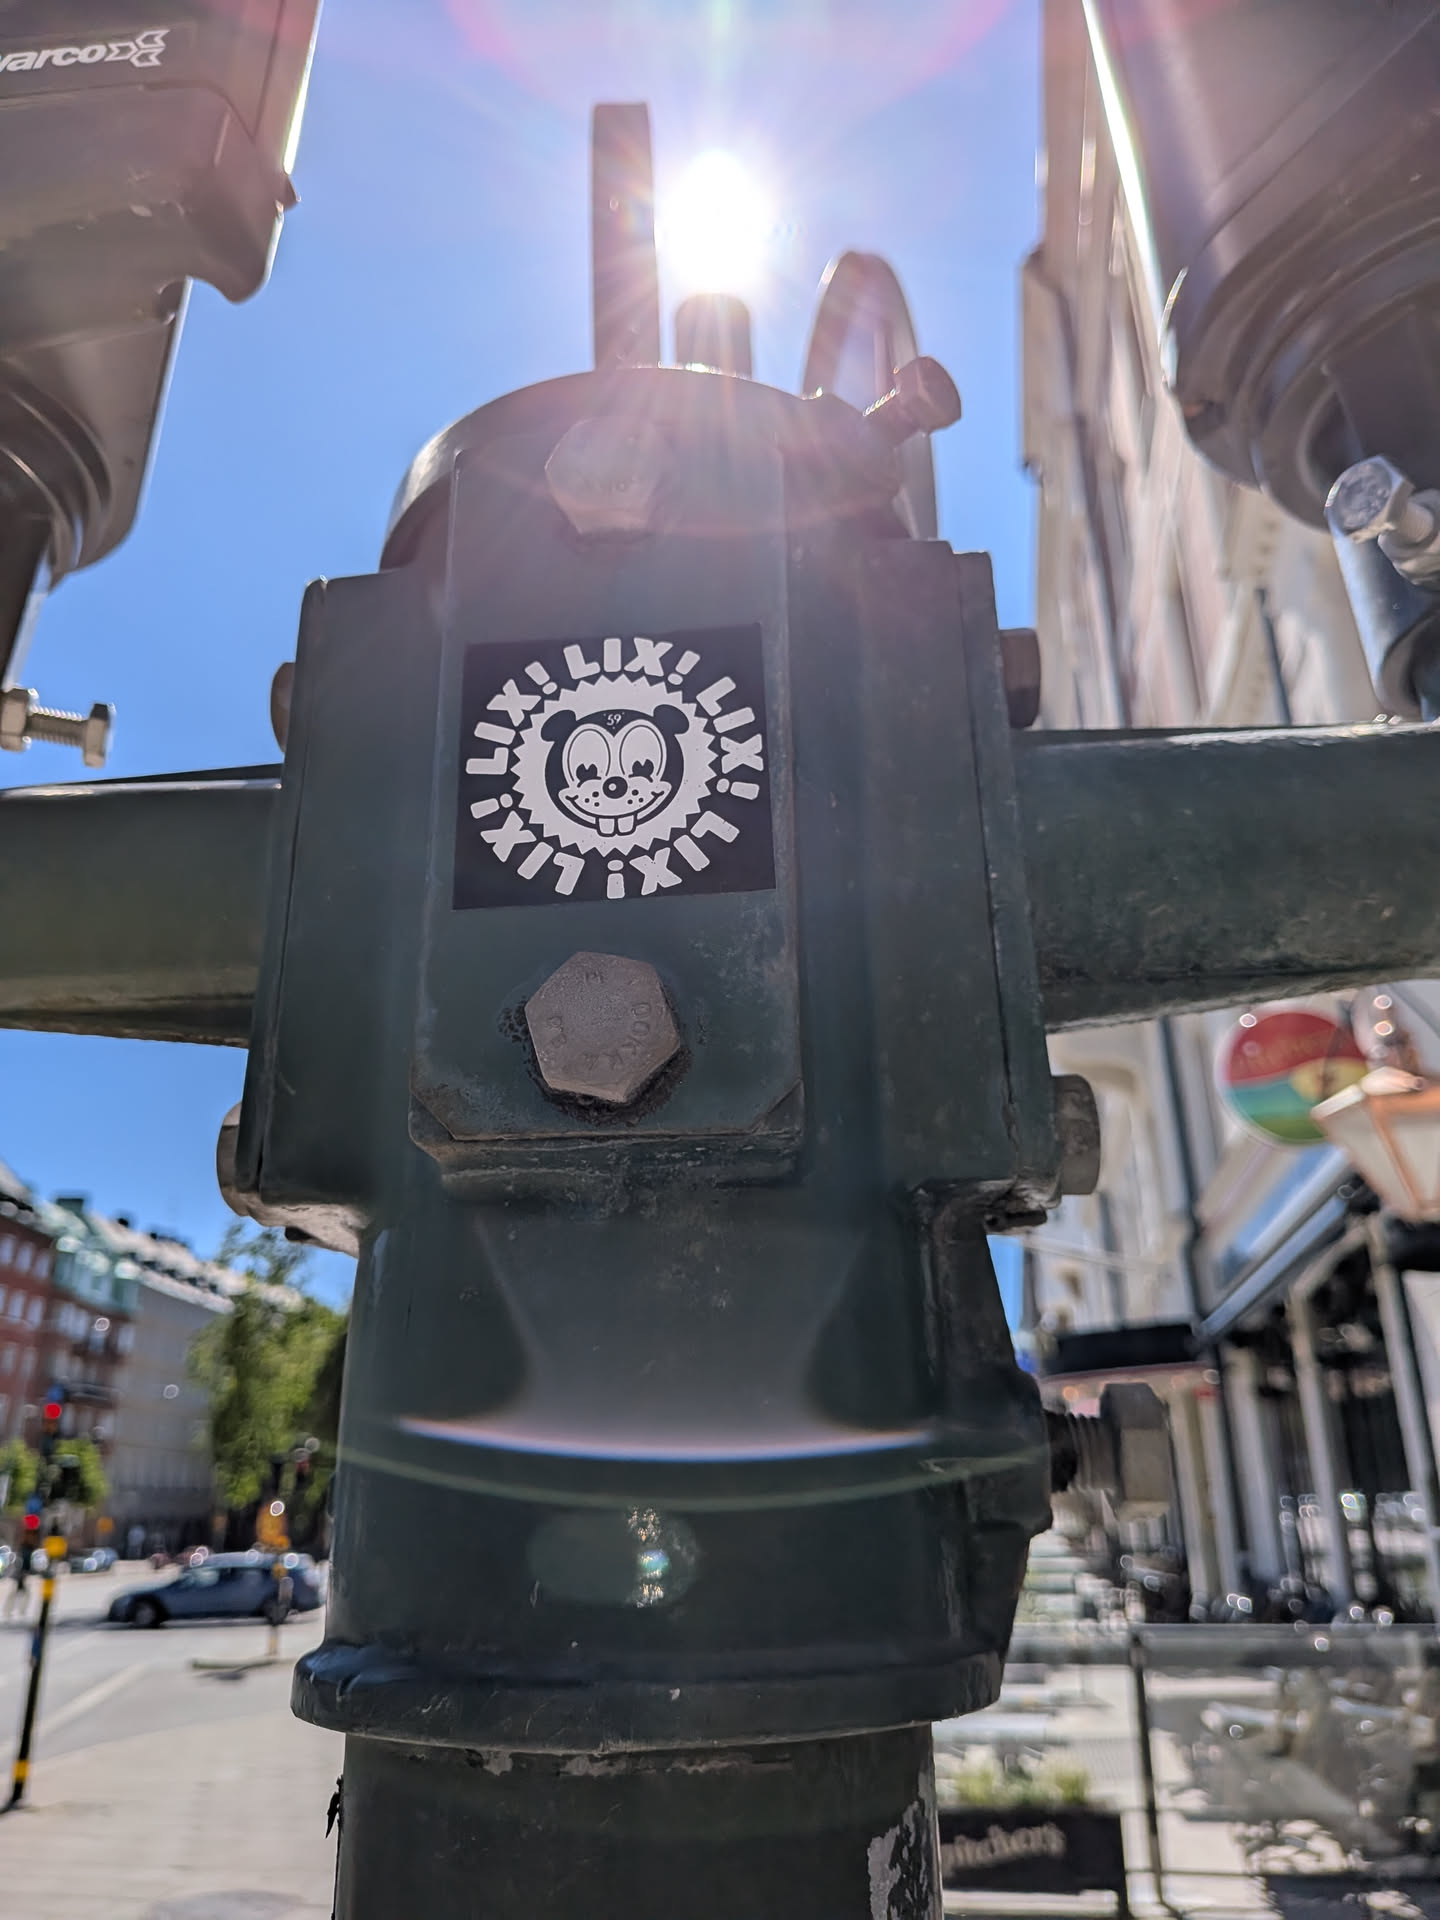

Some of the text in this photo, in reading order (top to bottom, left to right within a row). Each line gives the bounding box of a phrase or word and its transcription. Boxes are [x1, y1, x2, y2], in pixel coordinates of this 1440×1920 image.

[0, 44, 106, 73] arco
[563, 637, 700, 685] LIX!
[466, 661, 558, 775] LIX!
[606, 713, 622, 726] 59
[696, 676, 764, 800] LIX!
[470, 794, 585, 896] LIX!
[607, 811, 740, 900] LIX!
